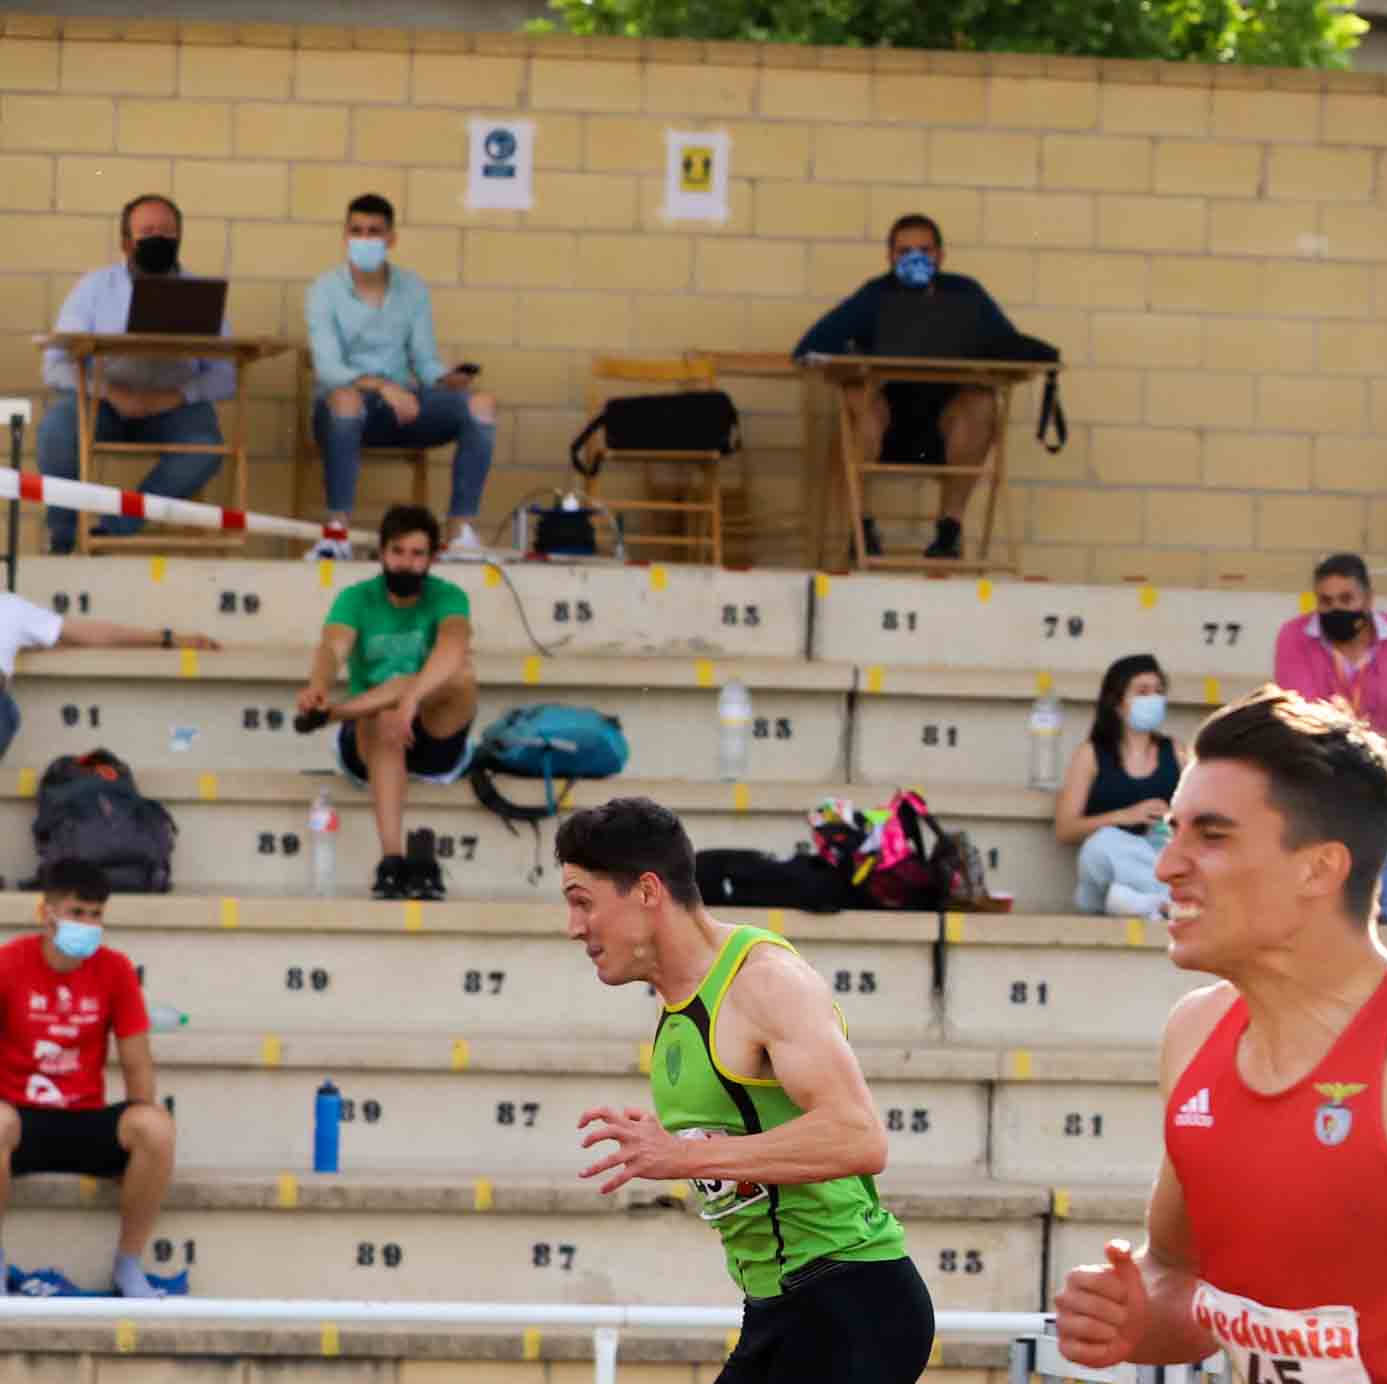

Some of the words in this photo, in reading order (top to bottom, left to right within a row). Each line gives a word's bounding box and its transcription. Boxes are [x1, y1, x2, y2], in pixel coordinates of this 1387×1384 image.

[52, 593, 90, 615] 91
[219, 591, 261, 615] 89
[881, 610, 917, 632] 81
[1043, 615, 1084, 638] 79
[1203, 622, 1241, 645] 77
[60, 704, 100, 728] 91
[242, 708, 284, 731] 89
[921, 725, 958, 747] 81
[258, 833, 301, 856] 89
[436, 835, 478, 860] 87
[286, 967, 329, 992] 89
[463, 970, 505, 995] 87
[1010, 981, 1048, 1005] 81
[341, 1098, 382, 1123] 89
[496, 1102, 540, 1127] 87
[1063, 1113, 1103, 1137] 81
[152, 1238, 195, 1265] 91
[356, 1242, 403, 1268] 89
[532, 1242, 576, 1271] 87
